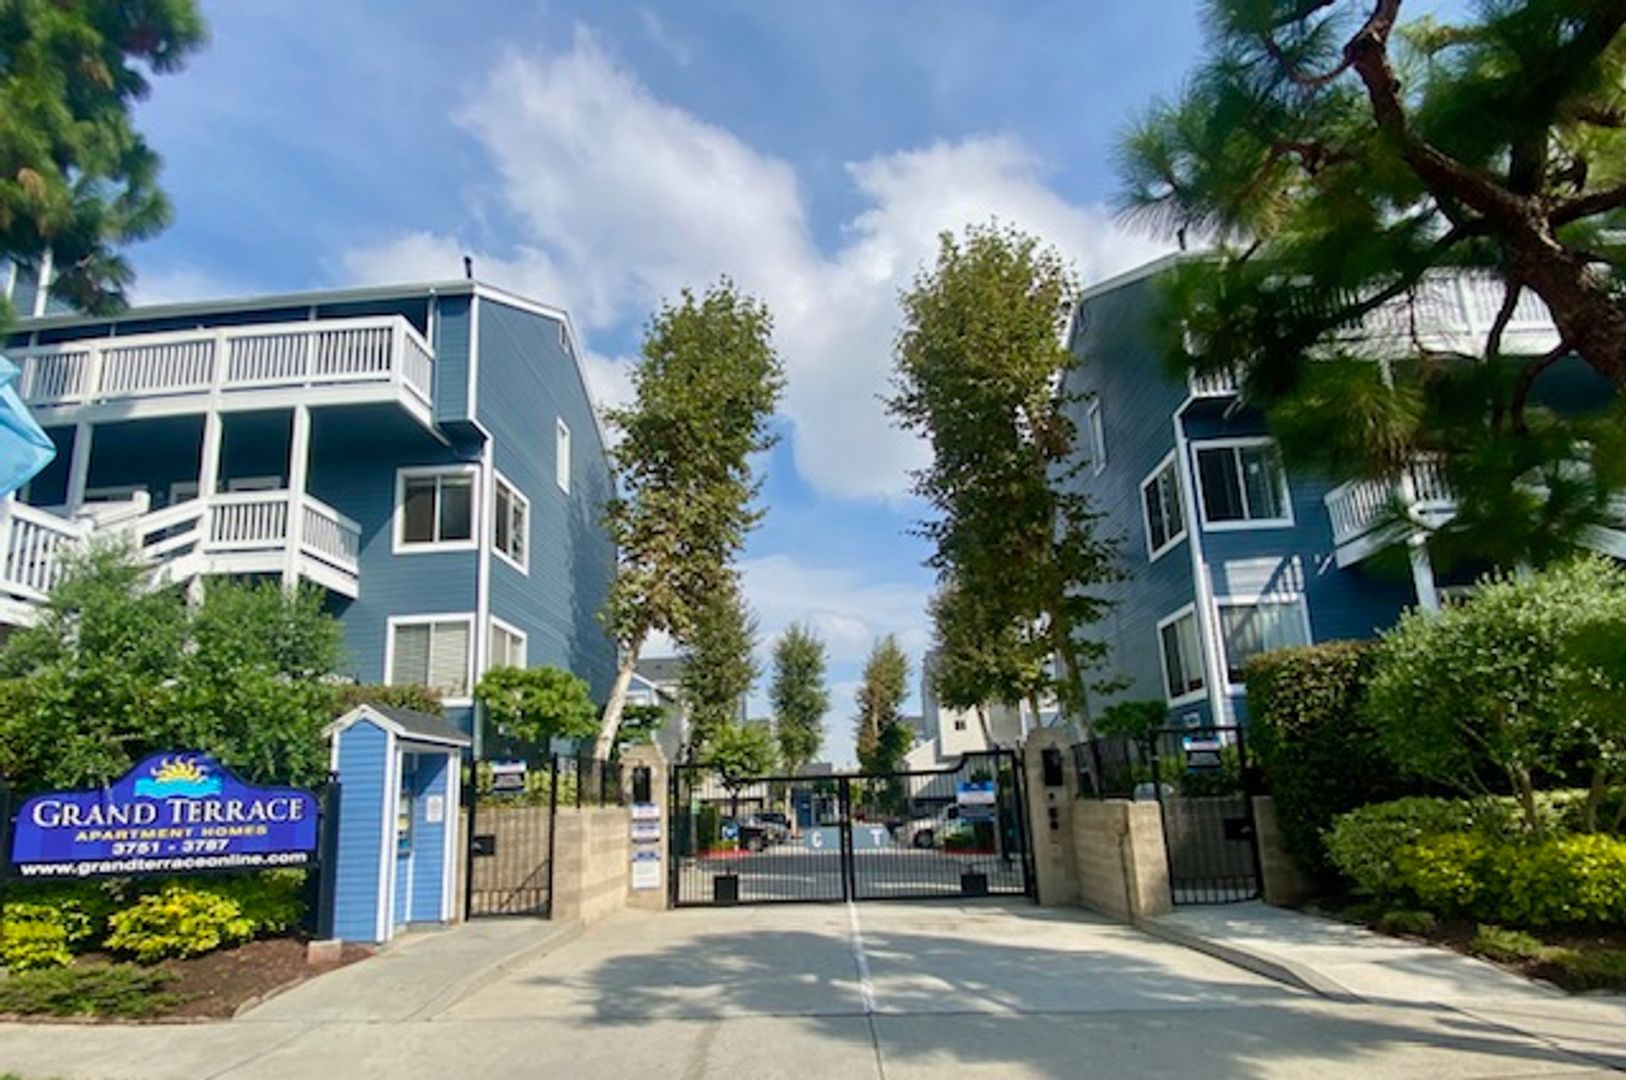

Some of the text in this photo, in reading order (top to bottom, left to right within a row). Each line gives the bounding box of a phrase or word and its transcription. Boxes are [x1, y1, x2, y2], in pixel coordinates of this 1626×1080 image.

[31, 798, 304, 827] GRAND TERRACE
[75, 825, 268, 842] APARTMENT HOMES
[869, 828, 883, 846] T
[112, 841, 160, 856] 3751
[181, 838, 230, 853] 3787
[20, 851, 308, 876] www.grandterraceonline.com
